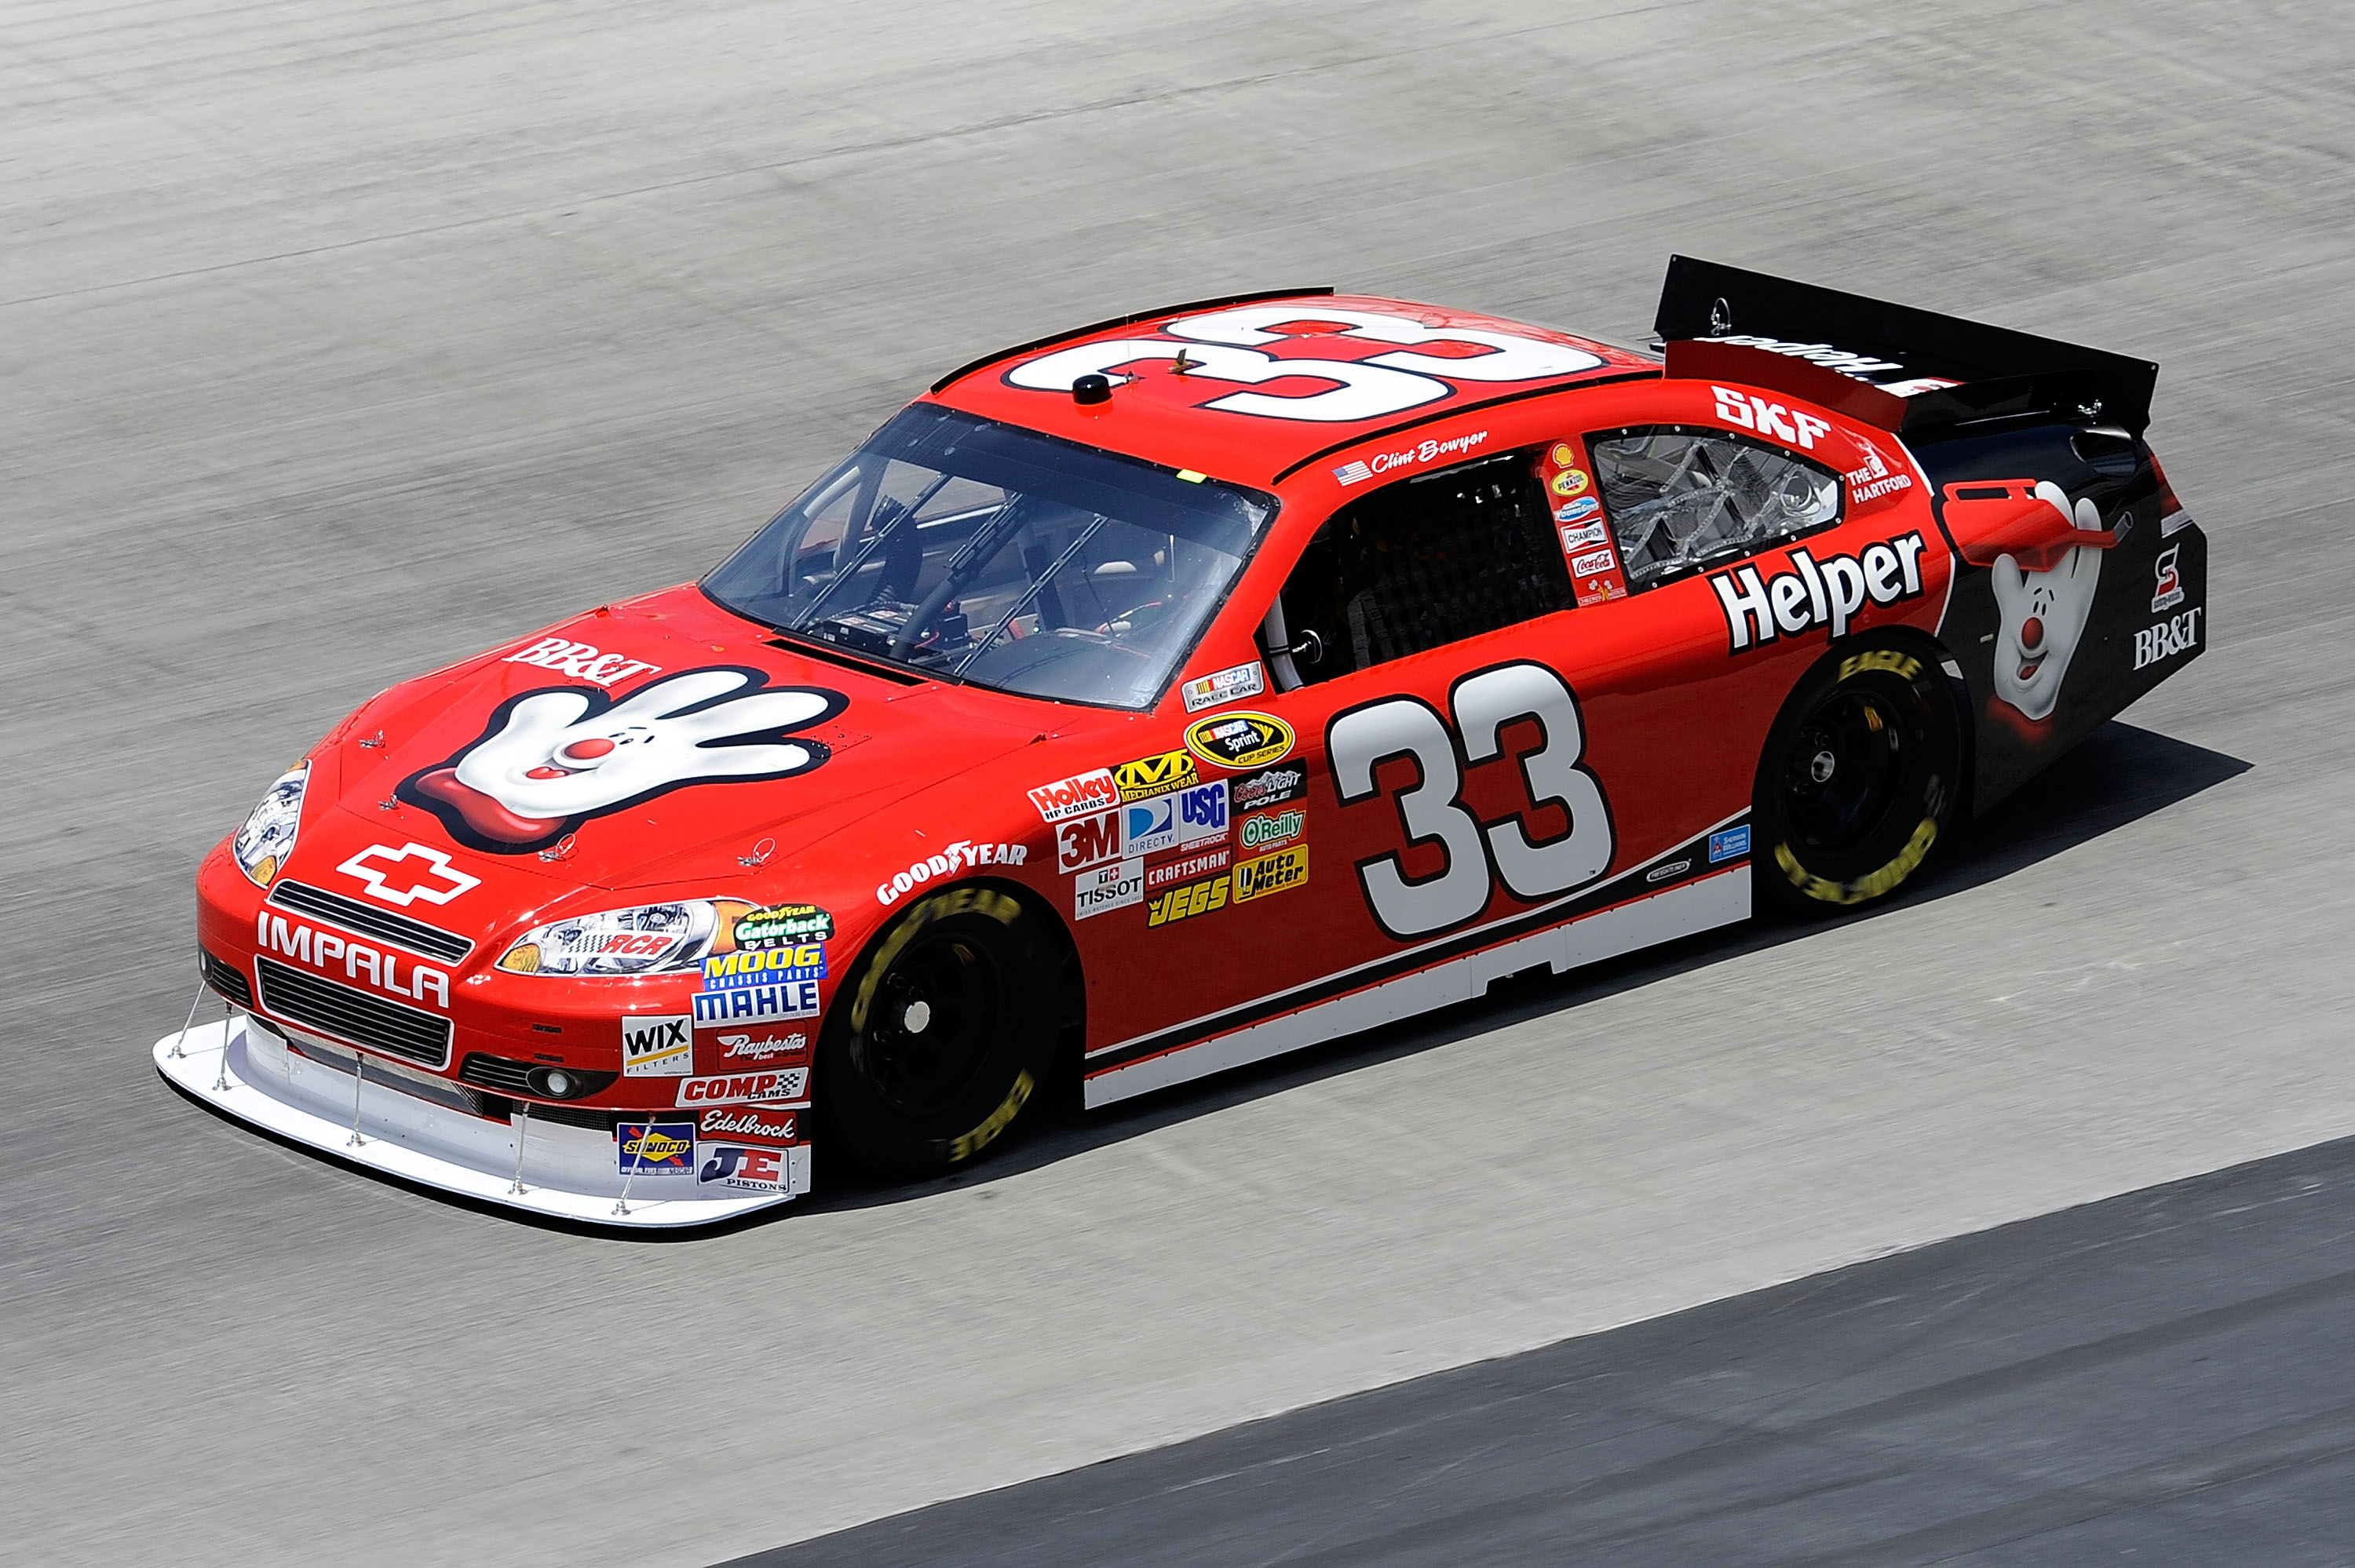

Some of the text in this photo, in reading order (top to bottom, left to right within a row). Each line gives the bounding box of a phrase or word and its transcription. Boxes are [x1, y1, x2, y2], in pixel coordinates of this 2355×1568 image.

[1003, 304, 1606, 424] 33
[1711, 385, 1831, 450] SKF
[1371, 431, 1488, 473] Clint Bowyer
[1846, 467, 1873, 487] THE
[1852, 474, 1912, 505] HARTFORD
[1568, 527, 1602, 544] CHAMPION
[1712, 534, 1926, 648] Helper
[2133, 607, 2201, 670] BB&T
[501, 637, 663, 687] BB&T
[1213, 669, 1250, 690] NASCAR
[1192, 684, 1256, 706] RACE CAR
[1213, 720, 1246, 739] NASCAR
[1225, 731, 1260, 752] Sprint
[1238, 745, 1285, 764] CUP SERIES
[1031, 775, 1116, 811] Holley
[1120, 773, 1199, 802] MECHANIX WEAR
[1234, 773, 1302, 803] Coors LIGHT
[1244, 790, 1291, 809] POLE
[1327, 662, 1614, 937] 33
[1045, 798, 1105, 819] HP CARBS
[1181, 784, 1225, 829] USG
[1061, 811, 1119, 868] 3M
[1129, 833, 1174, 853] DIRECTV
[1244, 814, 1304, 844] O'Reilly
[876, 840, 1028, 906] GOODYEAR
[1148, 850, 1230, 885] CRAFTSMAN
[1256, 855, 1294, 874] Auto
[1077, 877, 1142, 907] TISSOT
[1254, 866, 1304, 892] Meter
[747, 905, 816, 922] GOODYEAR
[1148, 876, 1231, 926] JEGS
[736, 914, 830, 941] Gatorback
[745, 932, 827, 951] BELTS
[258, 910, 449, 1008] IMPALA
[600, 935, 673, 955] RCR
[704, 944, 822, 979] MOOG
[710, 972, 768, 990] CHASSIS
[695, 982, 817, 1021] MAHLE
[625, 1019, 688, 1056] WIX
[717, 1033, 807, 1059] Raybestos
[626, 1052, 689, 1074] FILTERS
[685, 1074, 777, 1101] COMP
[747, 1088, 791, 1099] CAMS
[700, 1110, 795, 1138] Edelbrock
[700, 1147, 782, 1183] JE
[727, 1178, 787, 1191] PISTONS
